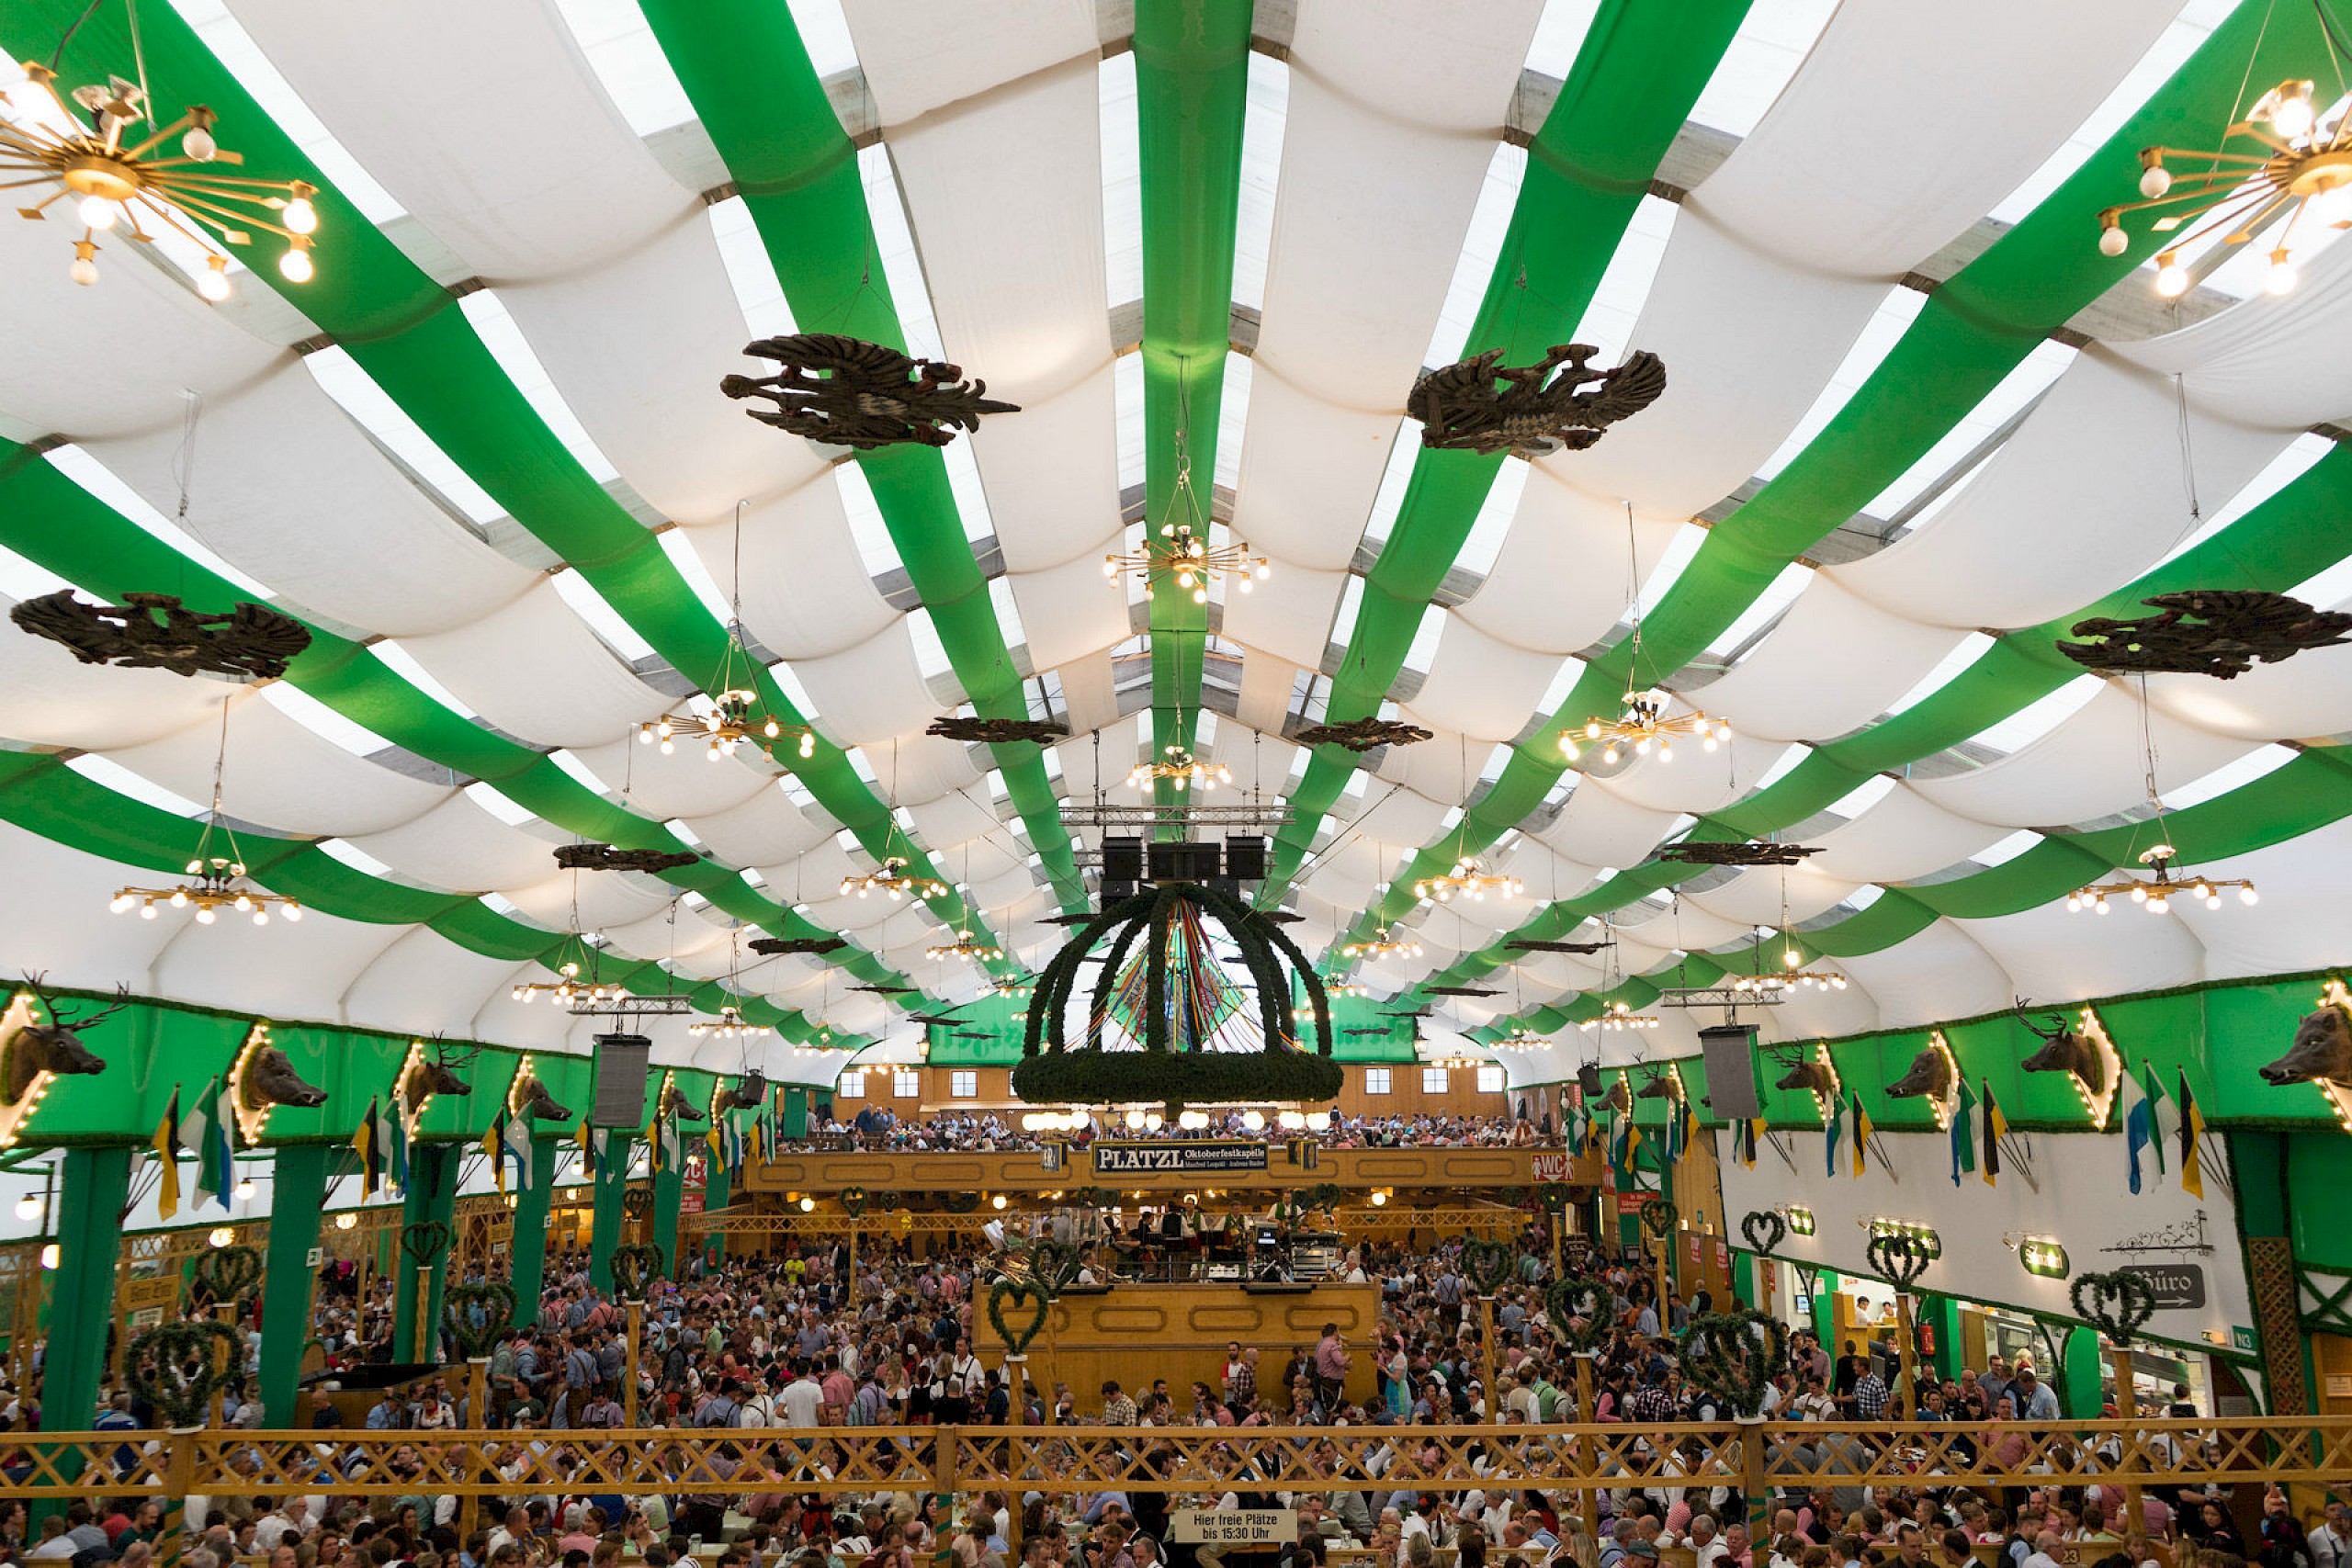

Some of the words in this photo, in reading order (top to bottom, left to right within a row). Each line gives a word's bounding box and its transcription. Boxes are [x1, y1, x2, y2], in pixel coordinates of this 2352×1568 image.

[1098, 1148, 1184, 1168] PLATZL
[1184, 1148, 1265, 1159] Oktoberfestkapelle
[1541, 1155, 1564, 1173] WC
[2237, 1333, 2252, 1348] N3
[1194, 1514, 1216, 1525] Hier
[1219, 1514, 1242, 1525] freie
[1246, 1514, 1277, 1525] Plätze
[1203, 1528, 1217, 1540] bis
[1221, 1528, 1248, 1540] 15:30
[1252, 1528, 1270, 1540] Uhr
[2062, 1549, 2077, 1562] 23
